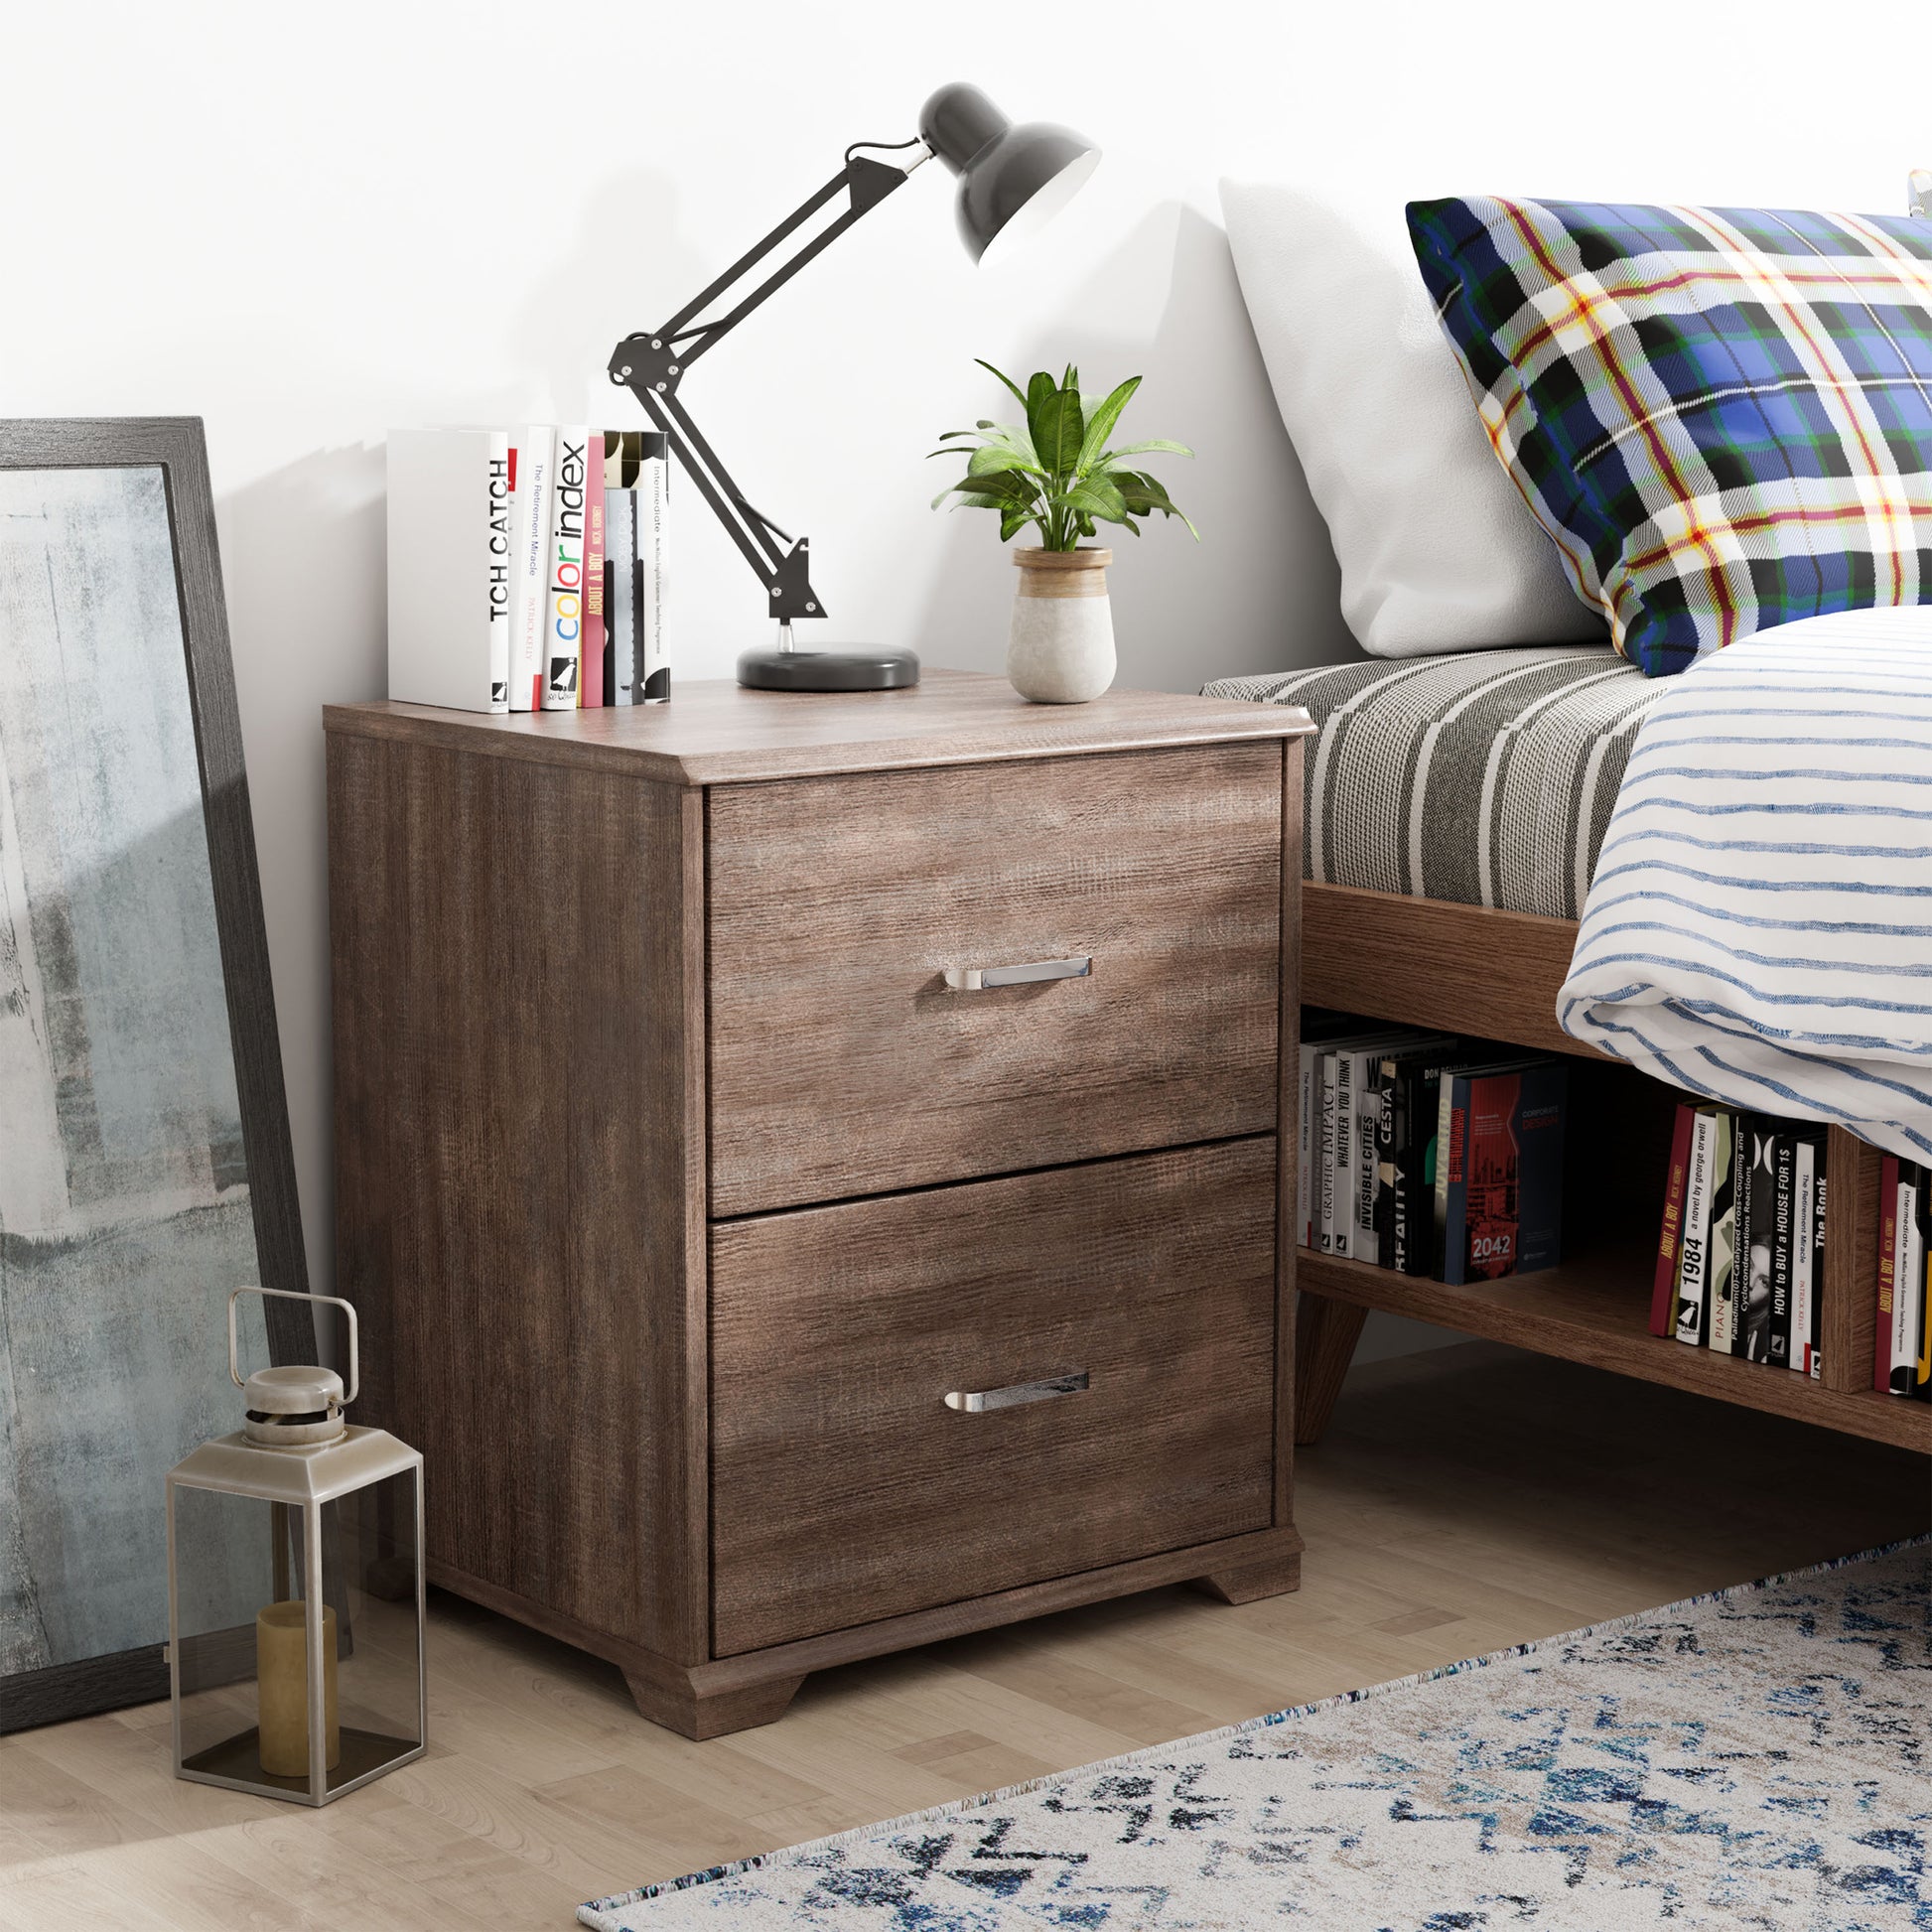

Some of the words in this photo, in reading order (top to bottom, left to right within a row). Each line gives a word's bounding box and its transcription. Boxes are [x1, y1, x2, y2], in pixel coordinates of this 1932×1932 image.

[535, 465, 544, 482] The
[554, 441, 585, 539] index
[489, 460, 508, 555] CATCH
[530, 484, 542, 538] Retirement
[619, 506, 629, 534] DICK
[529, 541, 538, 576] Miracle
[588, 552, 604, 572] BOY
[619, 536, 629, 573] MOBY
[489, 565, 508, 621] TCH
[551, 544, 581, 640] color
[589, 574, 604, 584] A
[526, 598, 535, 633] PATRICK
[588, 586, 604, 616] ABOUT
[525, 635, 534, 660] KELLY
[1338, 1058, 1350, 1088] THINK
[1338, 1092, 1350, 1111] YOU
[1381, 1088, 1392, 1144] CESTA
[1322, 1080, 1334, 1156] IMPACT
[1337, 1116, 1349, 1168] WHATEVER
[1362, 1116, 1373, 1160] CITIES
[1436, 1098, 1449, 1199] JUVENTUD
[1698, 1124, 1707, 1152] orwell
[1696, 1152, 1705, 1183] george
[1779, 1149, 1791, 1163] 1$
[1323, 1158, 1332, 1219] GRAPHIC
[1672, 1165, 1683, 1185] HORNBY
[1694, 1184, 1702, 1196] by
[1743, 1166, 1752, 1213] Reactions
[1778, 1167, 1790, 1190] FOR
[1362, 1164, 1372, 1231] INVISIBLE
[1735, 1154, 1745, 1229] Cross-Coupling
[1666, 1202, 1679, 1220] BOY
[1692, 1196, 1701, 1221] novel
[1777, 1193, 1788, 1231] HOUSE
[1668, 1220, 1677, 1230] A
[1815, 1219, 1825, 1248] The
[1885, 1217, 1894, 1237] HORNBY
[1473, 1235, 1511, 1259] 2042
[1660, 1231, 1675, 1259] ABOUT
[1775, 1246, 1787, 1270] BUY
[1682, 1237, 1702, 1285] 1984
[1741, 1215, 1751, 1311] Cyclocondensations
[1881, 1257, 1894, 1274] BOY
[1731, 1229, 1742, 1340] Palladium(0)-Catalyzed
[1777, 1273, 1785, 1285] to
[1882, 1274, 1894, 1284] A
[1774, 1287, 1786, 1315] HOW
[1878, 1285, 1893, 1314] ABOUT
[1715, 1293, 1726, 1339] PIANO
